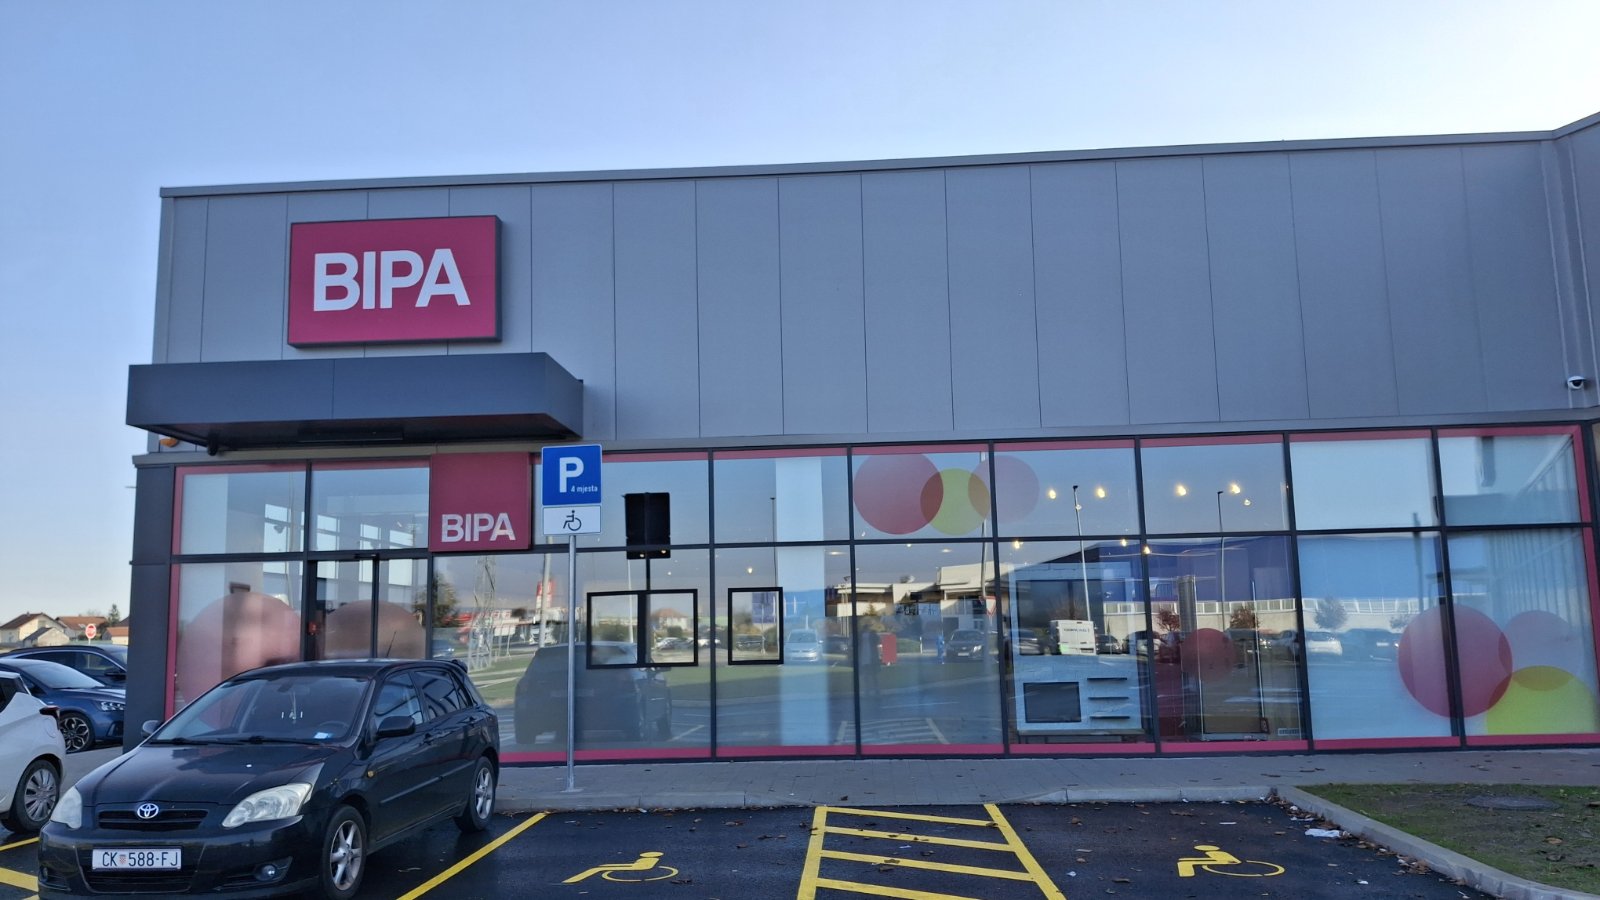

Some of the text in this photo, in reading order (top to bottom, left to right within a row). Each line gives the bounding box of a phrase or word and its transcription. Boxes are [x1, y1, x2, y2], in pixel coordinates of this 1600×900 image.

[313, 248, 471, 312] BIPA
[559, 456, 584, 493] P
[576, 485, 598, 493] mjesta
[441, 512, 516, 542] BIPA
